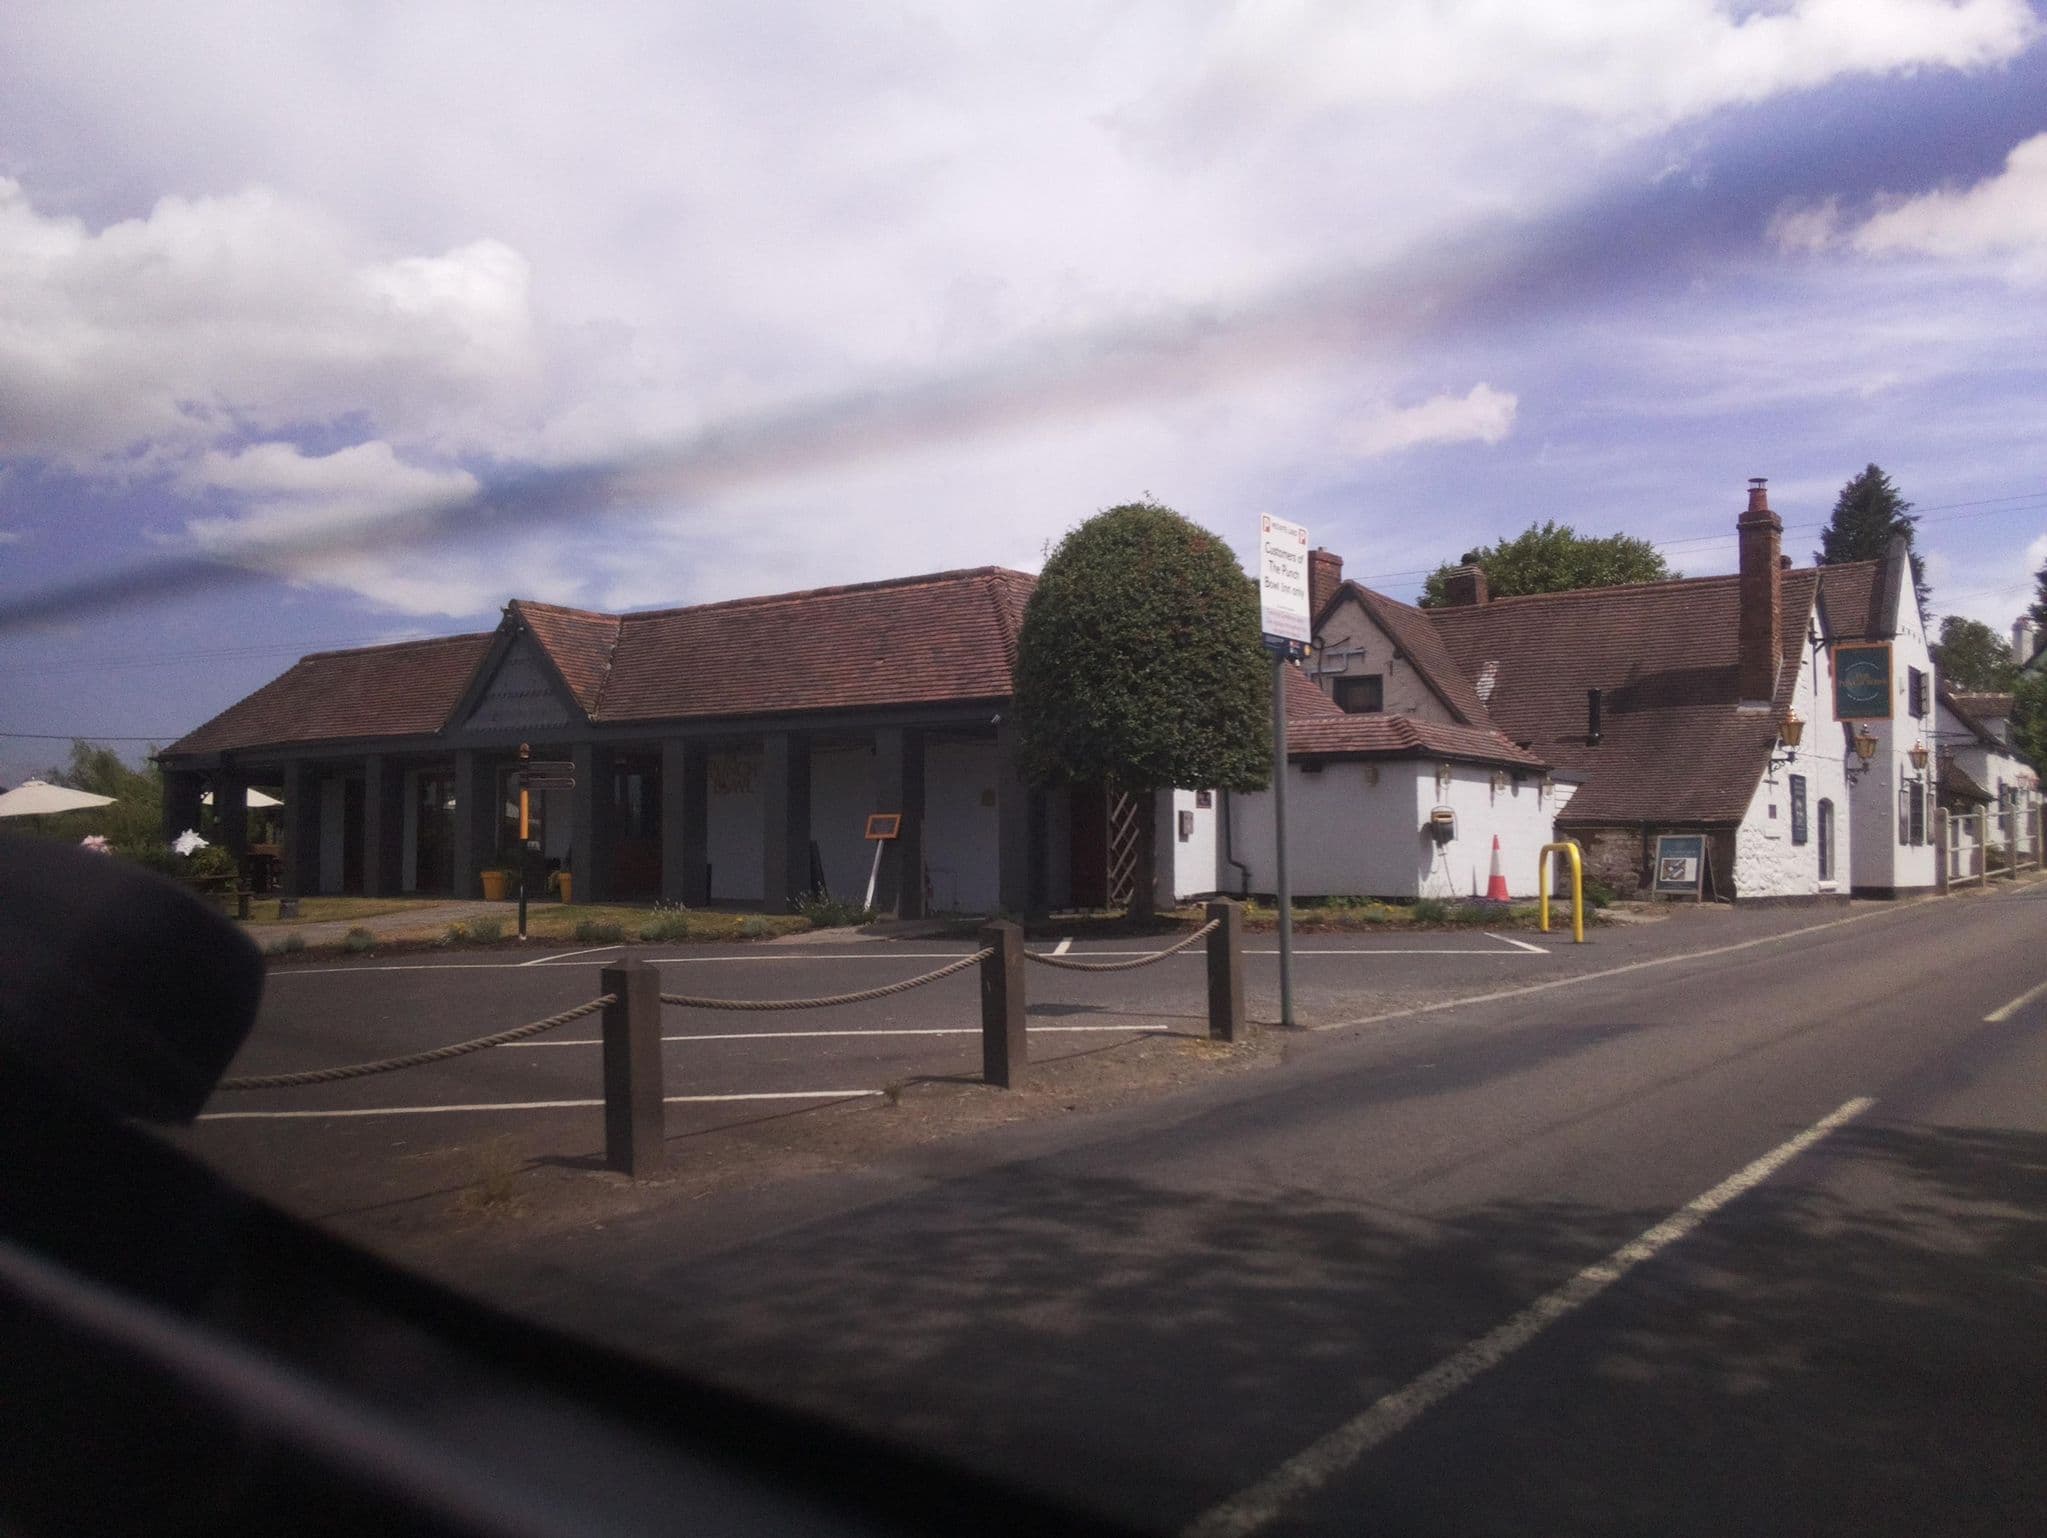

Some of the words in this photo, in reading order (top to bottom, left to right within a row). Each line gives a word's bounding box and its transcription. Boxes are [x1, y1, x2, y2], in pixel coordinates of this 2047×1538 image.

[1265, 541, 1297, 562] Customers
[1298, 555, 1304, 564] of
[1268, 559, 1281, 575] The
[1281, 563, 1300, 580] Punch
[1264, 576, 1280, 590] Bowl
[1281, 582, 1292, 593] Inn
[1292, 588, 1305, 600] only
